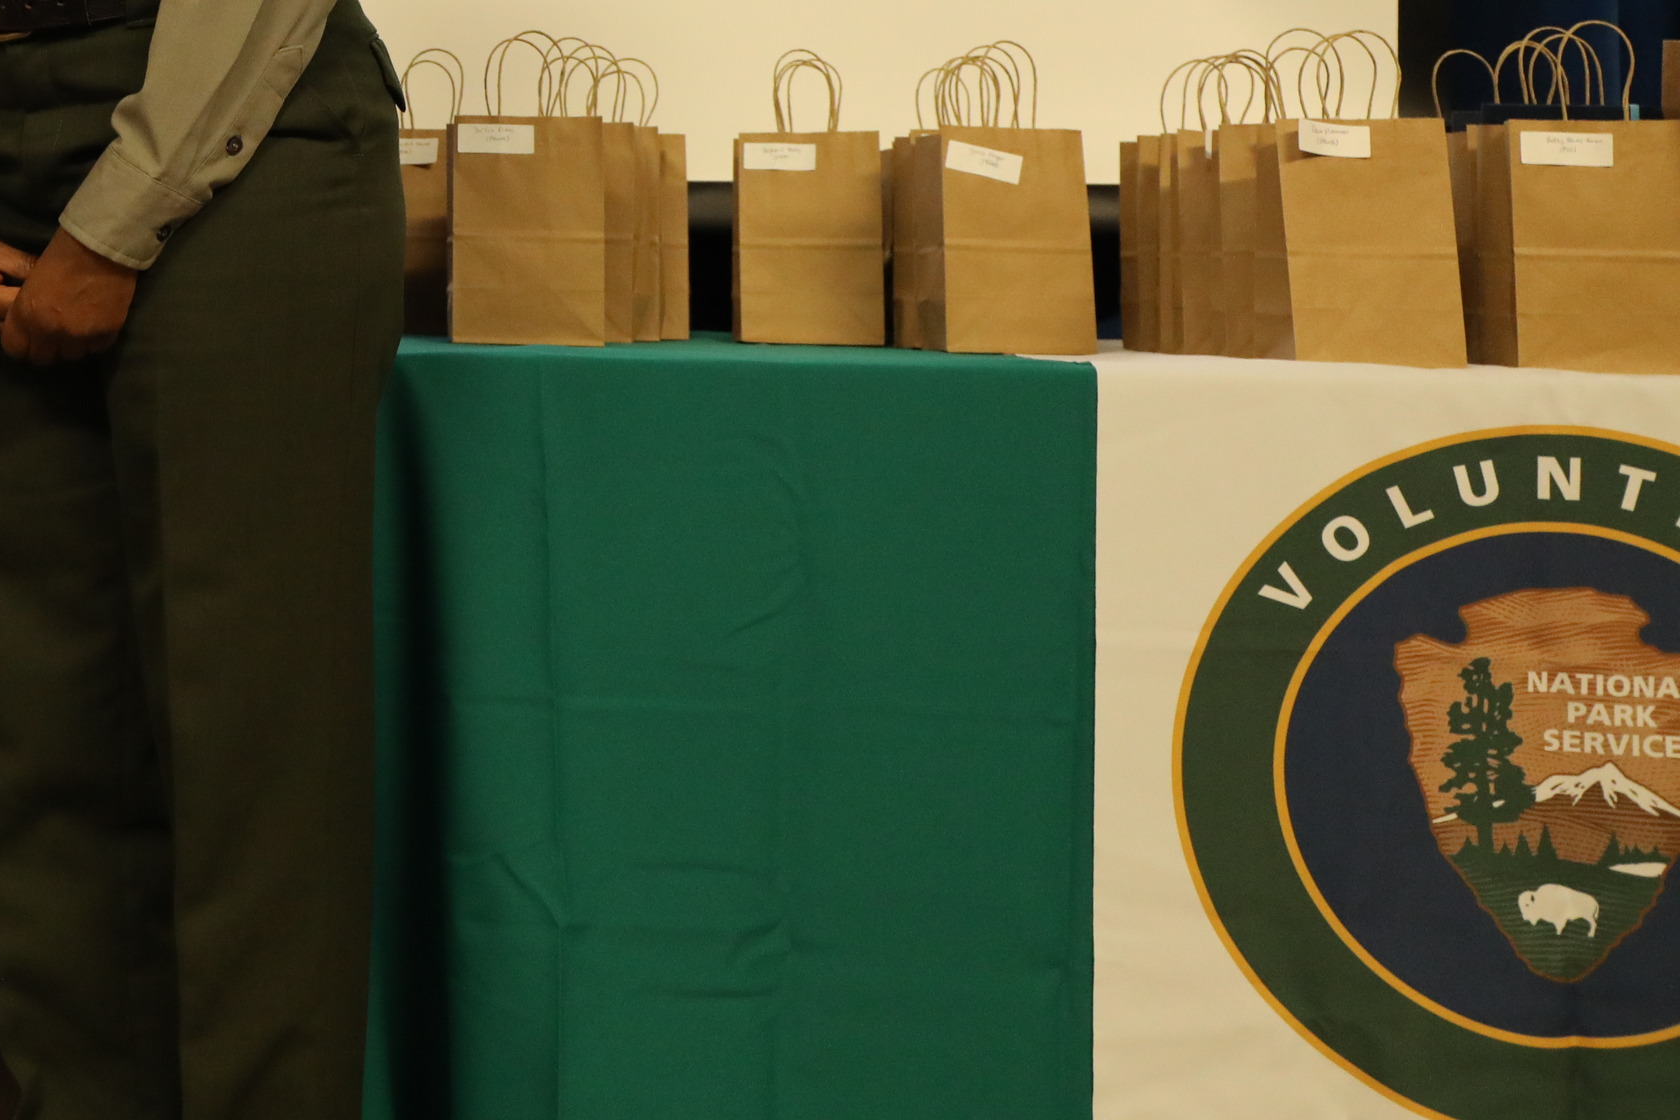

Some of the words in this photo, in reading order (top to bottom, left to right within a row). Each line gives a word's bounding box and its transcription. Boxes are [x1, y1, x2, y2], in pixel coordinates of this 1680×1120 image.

[1257, 455, 1680, 611] VOLUNT
[1566, 700, 1658, 729] PARK
[1542, 728, 1680, 759] SERVICE
